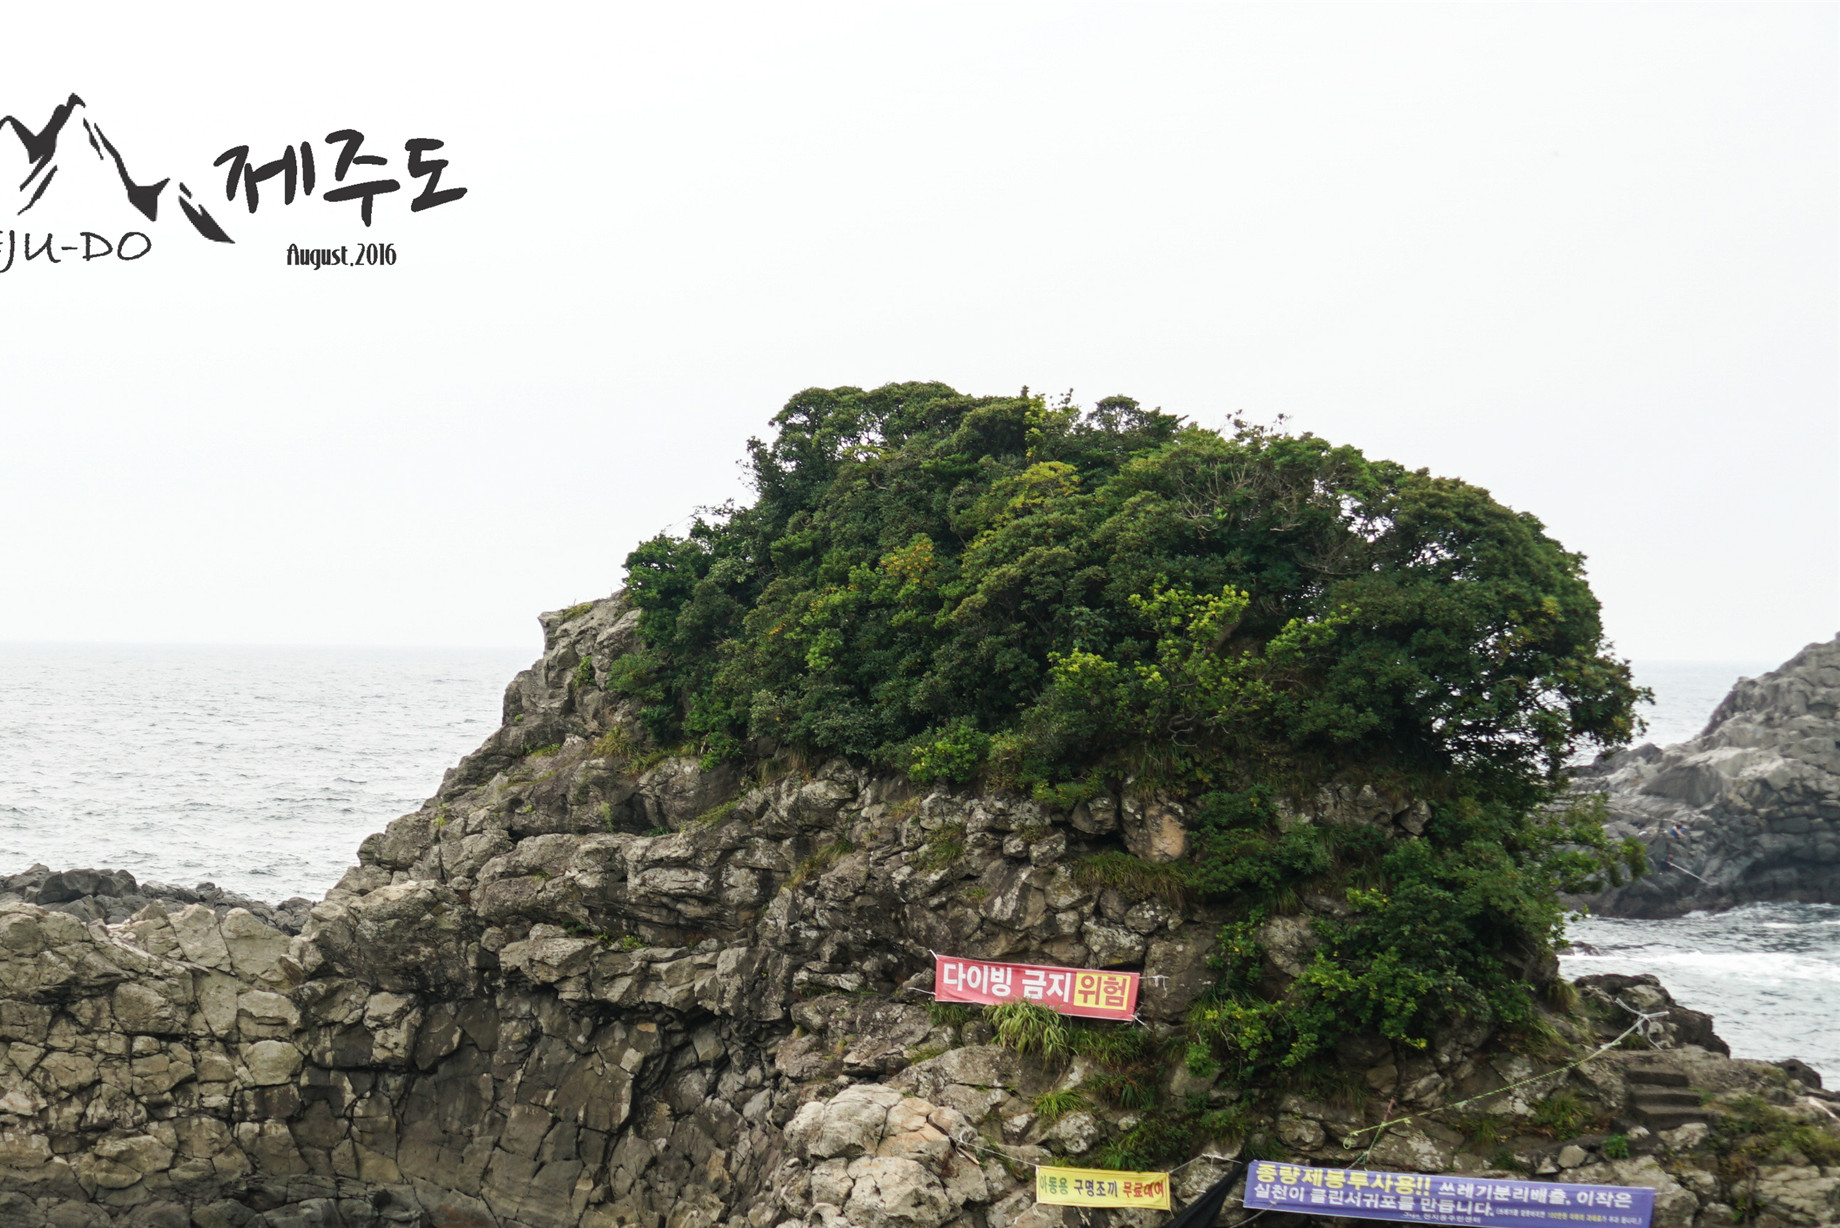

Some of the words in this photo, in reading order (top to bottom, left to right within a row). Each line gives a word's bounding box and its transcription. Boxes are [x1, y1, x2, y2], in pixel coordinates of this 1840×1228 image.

[943, 962, 1011, 997] 다이빙
[1021, 970, 1071, 1003] 금지
[1077, 975, 1127, 1007] 위험
[1074, 1179, 1118, 1198] 구명조끼
[1122, 1179, 1165, 1198] 무료대여
[1254, 1183, 1305, 1202] 실천이
[1310, 1187, 1416, 1211] 클린서귀포를
[1421, 1197, 1495, 1217] 만듭니다.
[1256, 1163, 1430, 1196] 종량제봉투사용!!
[1576, 1190, 1632, 1210] 이작은
